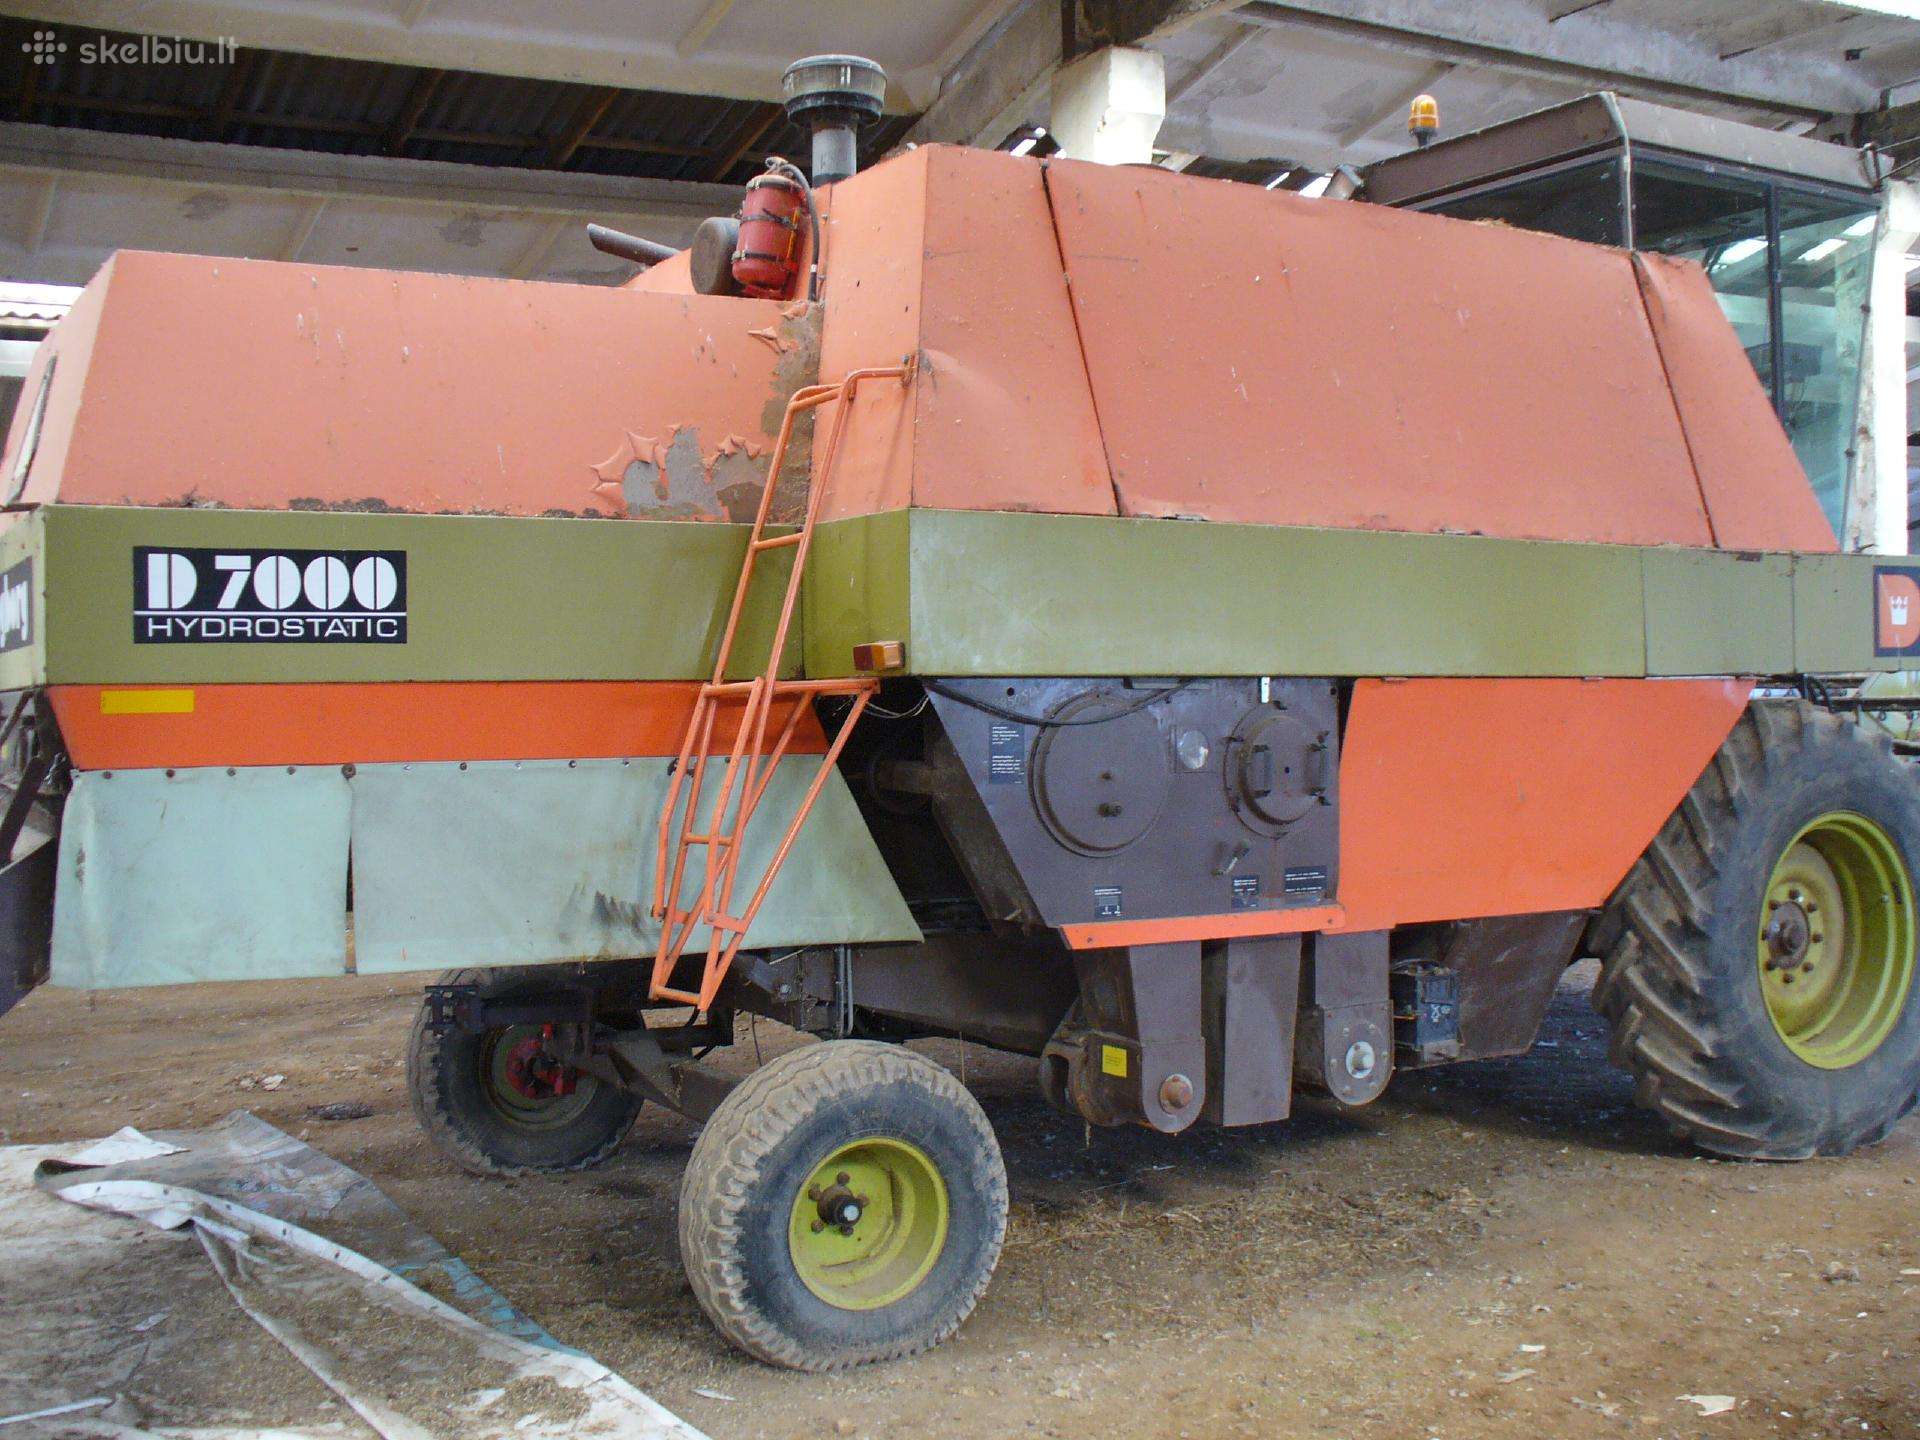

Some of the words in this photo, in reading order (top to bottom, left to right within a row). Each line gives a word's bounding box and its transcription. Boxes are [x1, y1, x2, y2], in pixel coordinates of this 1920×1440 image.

[147, 553, 198, 611] D
[214, 554, 398, 611] 7000
[147, 617, 399, 638] HYDROSTATIC
